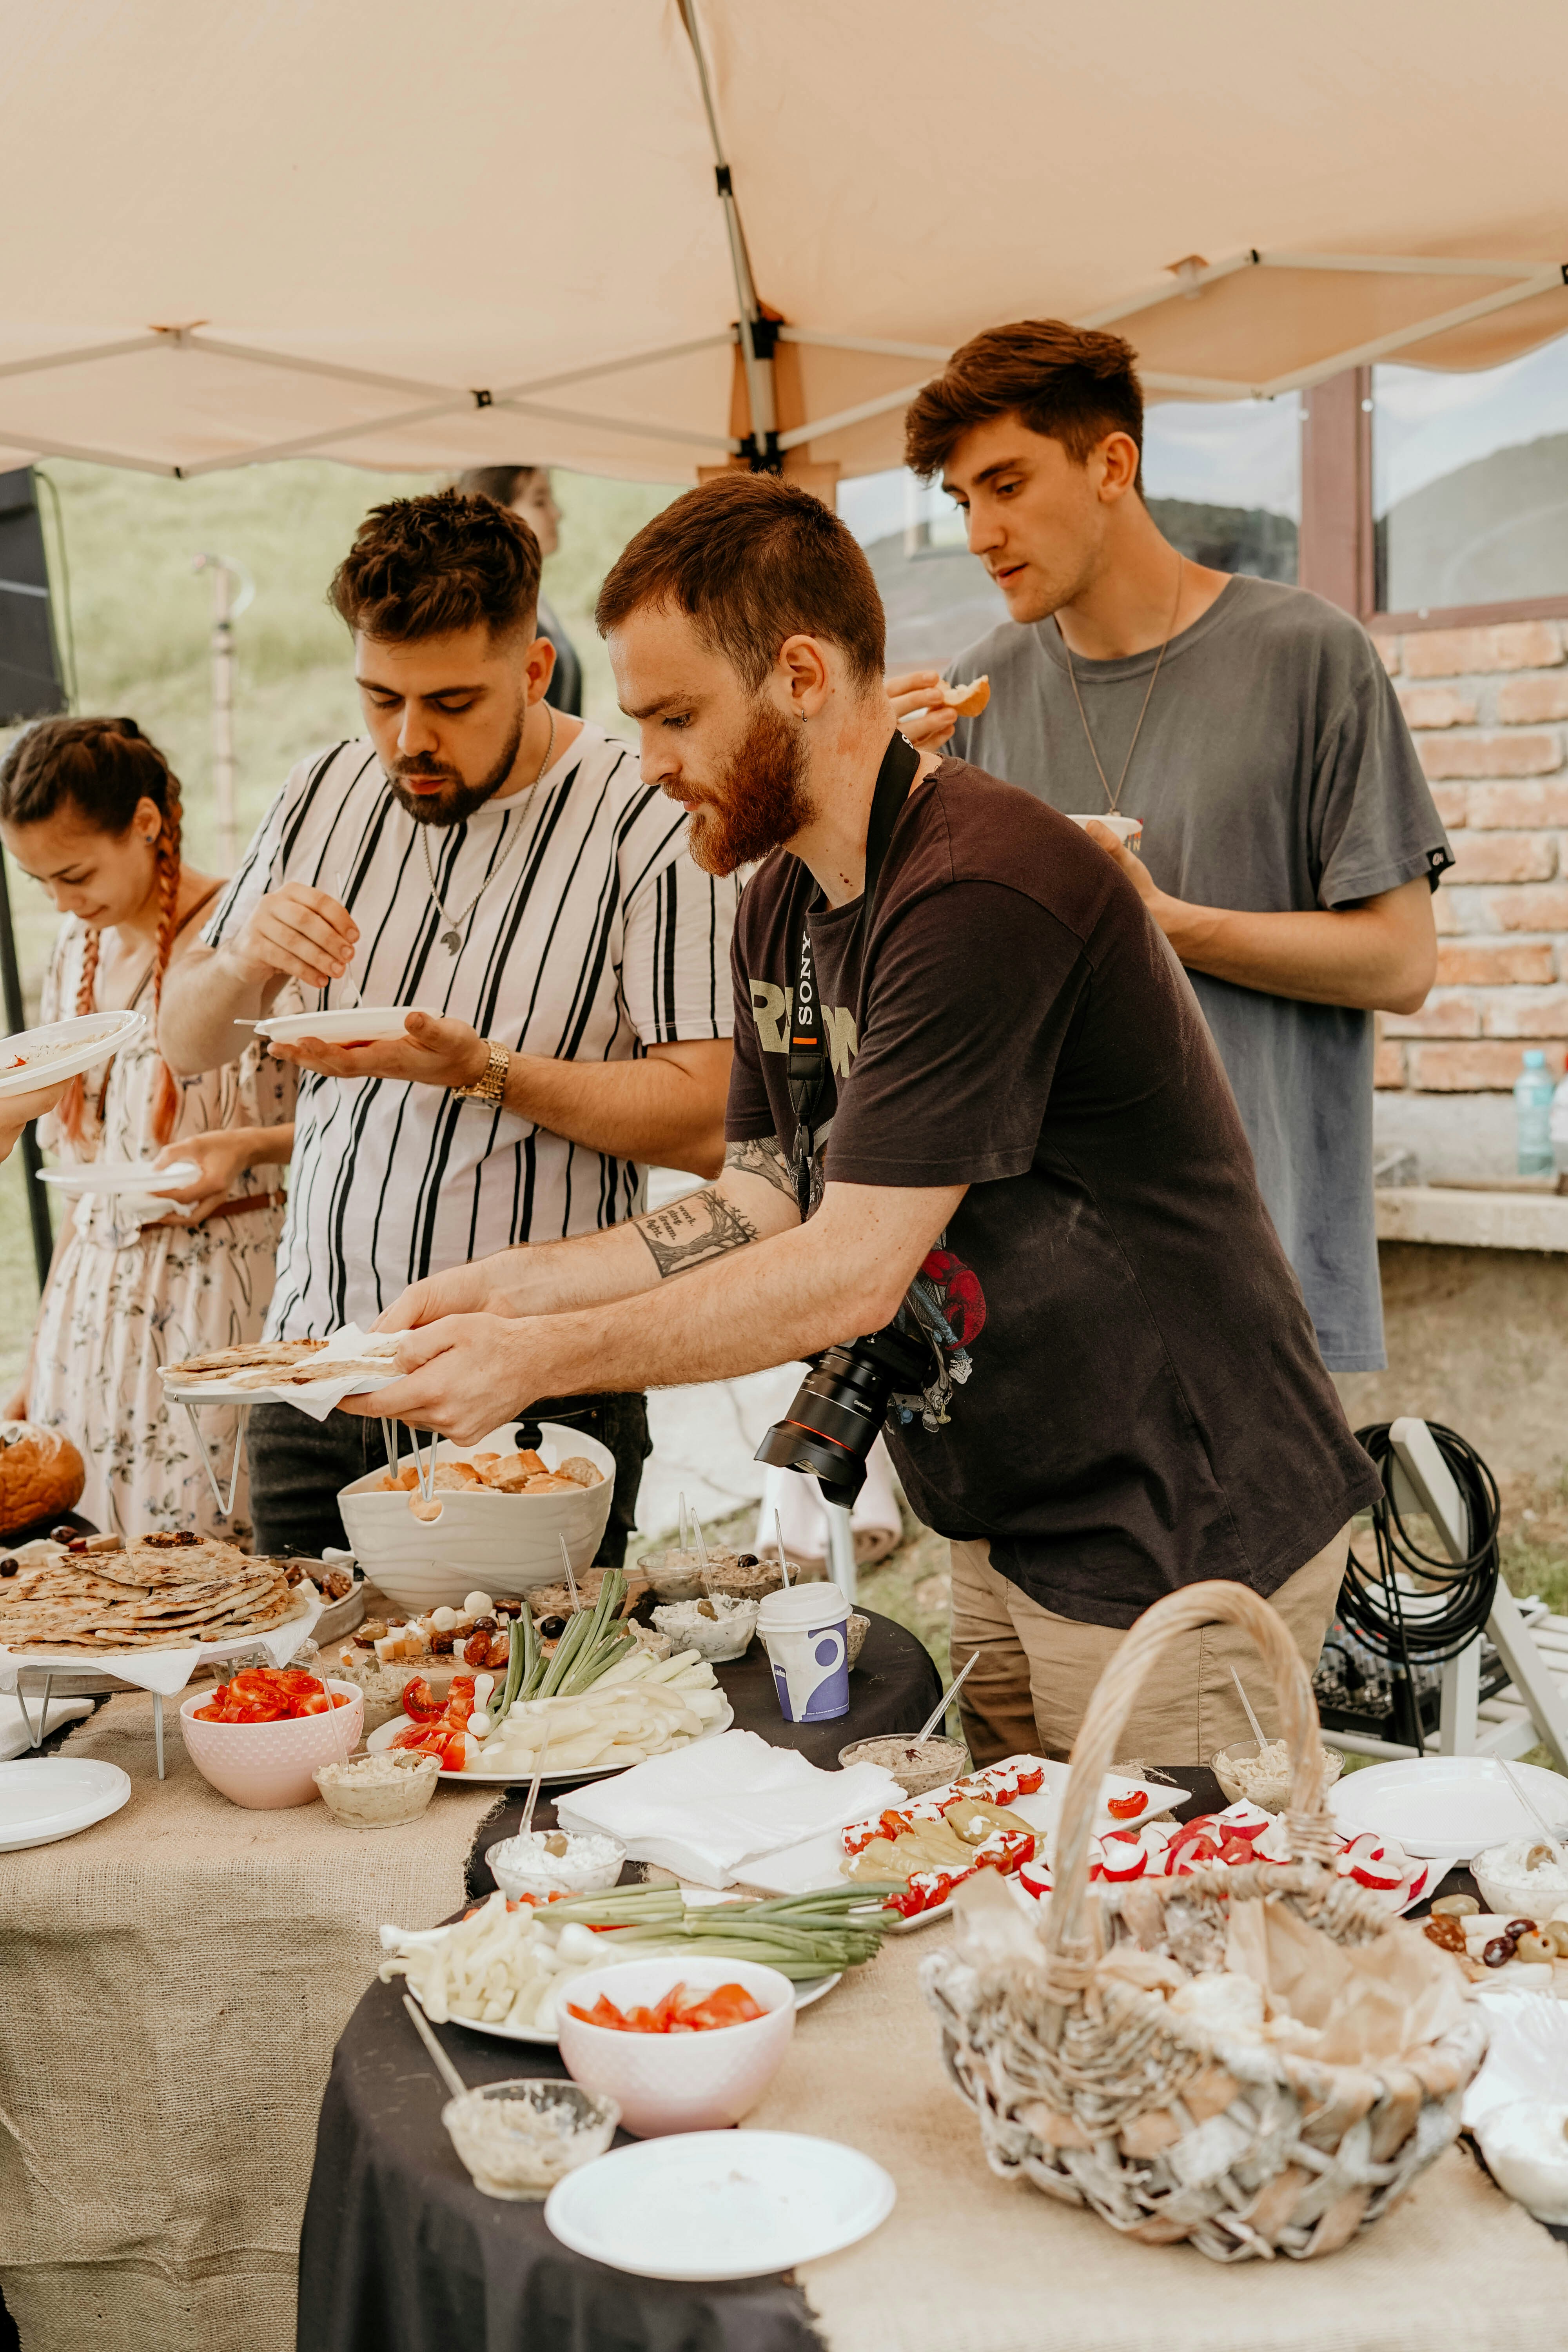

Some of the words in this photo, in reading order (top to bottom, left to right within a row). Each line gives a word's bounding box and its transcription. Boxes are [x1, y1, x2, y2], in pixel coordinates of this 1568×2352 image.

[798, 931, 813, 1025] SONY
[658, 1215, 676, 1240] dream.
[679, 1205, 696, 1226] work.
